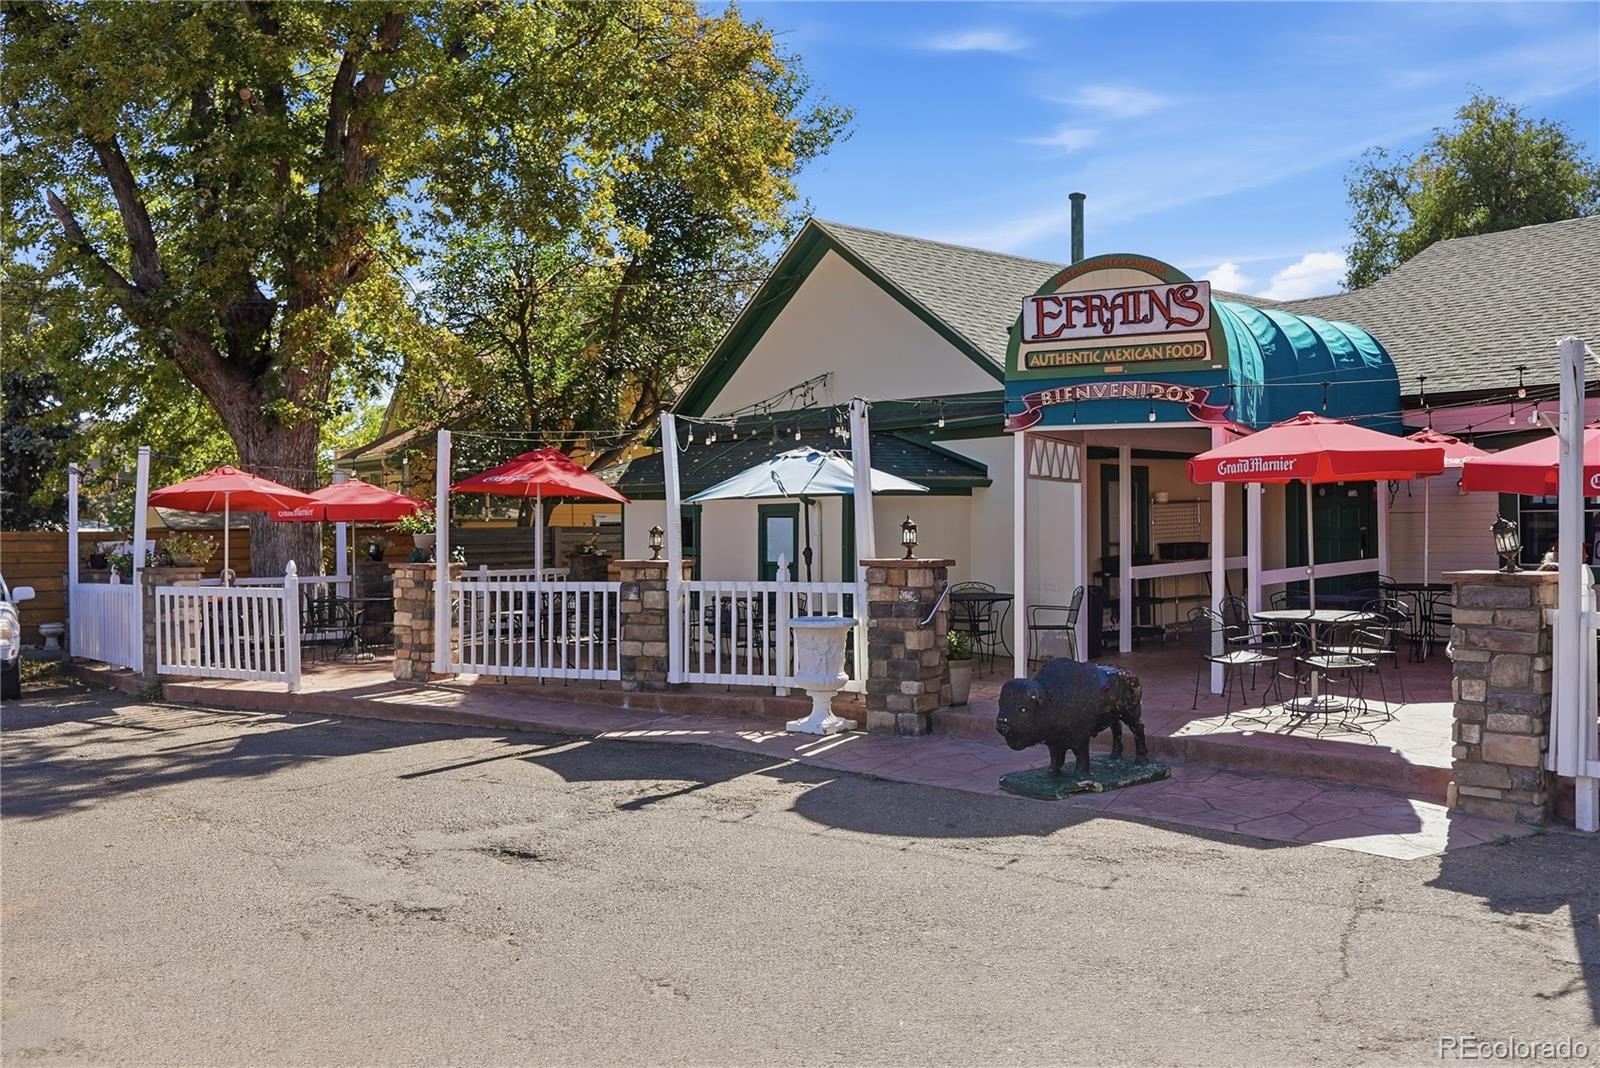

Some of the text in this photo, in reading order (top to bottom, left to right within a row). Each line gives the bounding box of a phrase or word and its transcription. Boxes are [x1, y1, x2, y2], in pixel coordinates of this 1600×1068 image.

[1031, 284, 1205, 340] EFRAINS
[1030, 344, 1204, 367] AUTHENTIC MEXICAN FOOD
[1041, 383, 1195, 406] BIENVENIDOS
